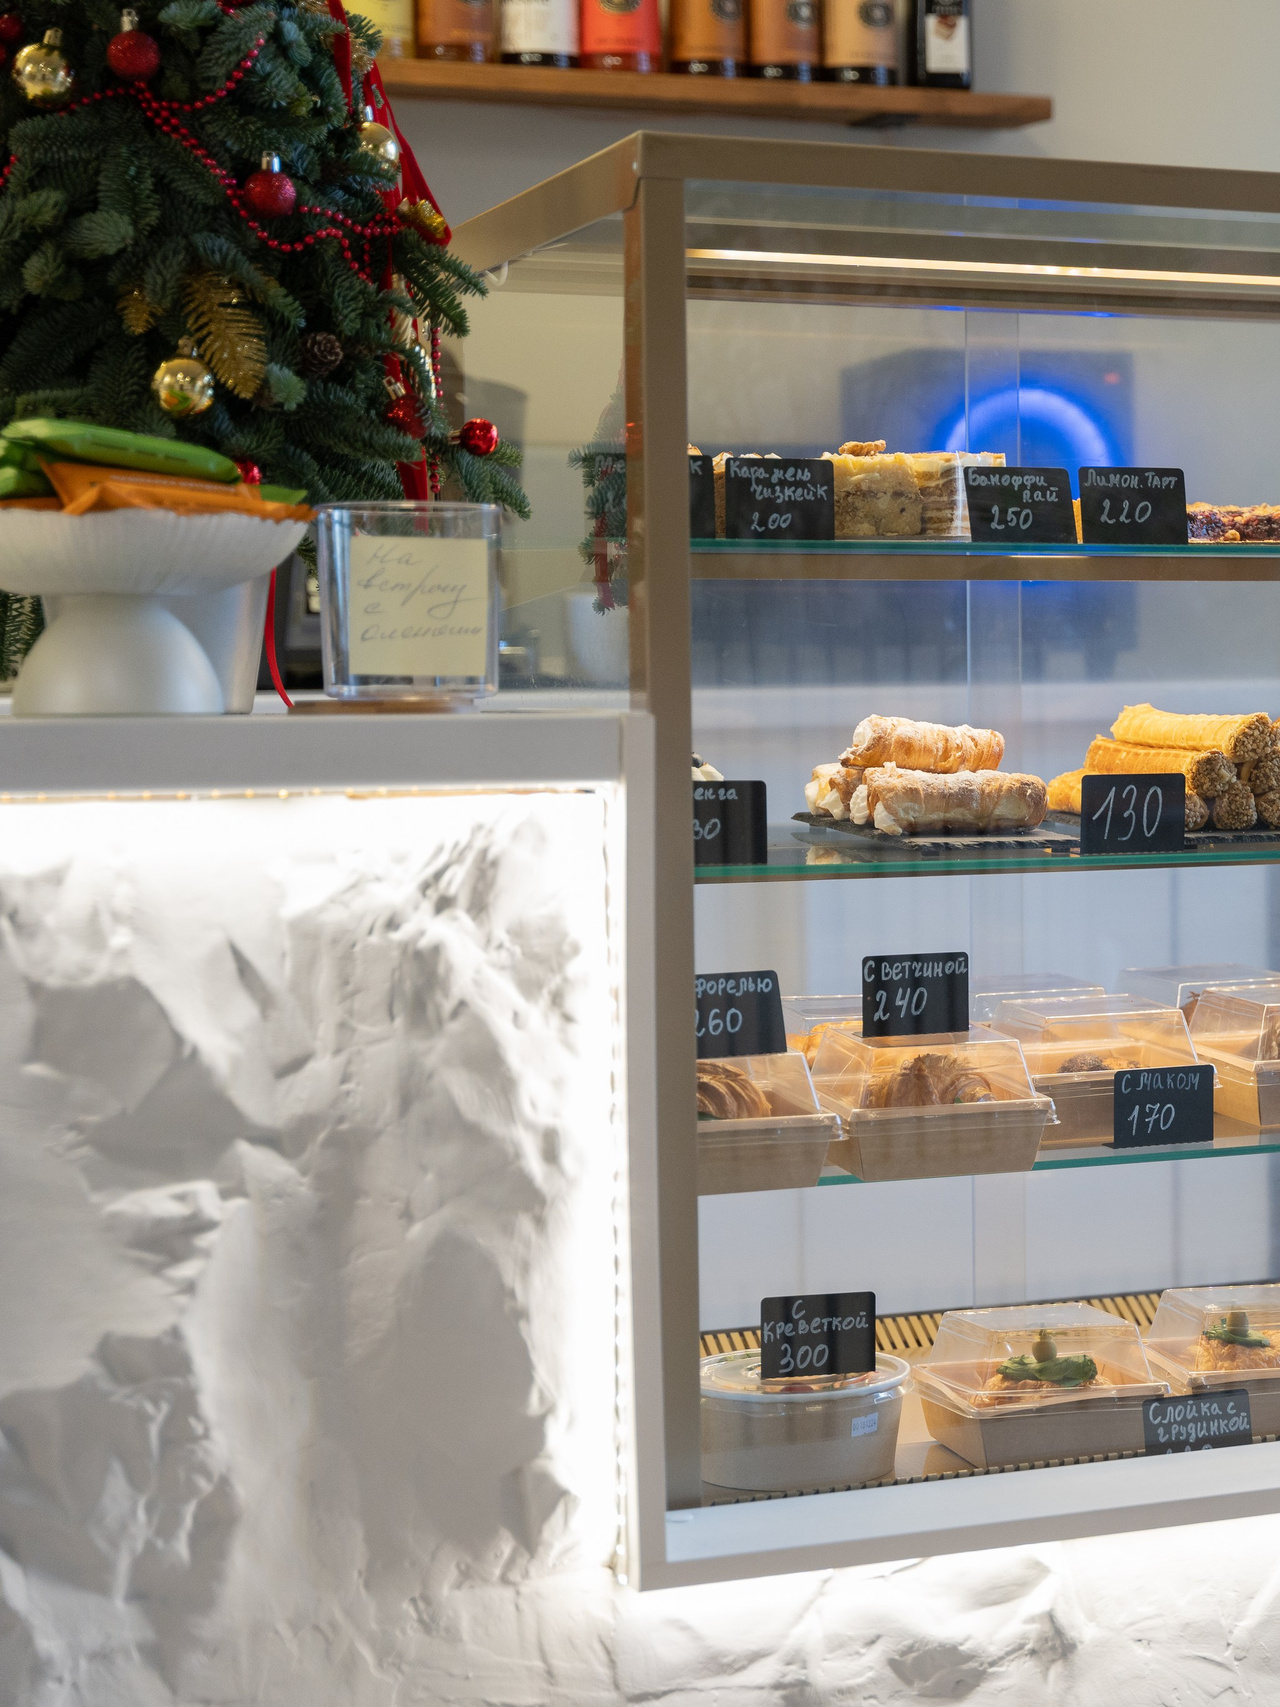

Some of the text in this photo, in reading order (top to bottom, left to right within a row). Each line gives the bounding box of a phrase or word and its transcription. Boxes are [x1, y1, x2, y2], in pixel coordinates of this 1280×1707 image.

[967, 467, 1048, 491] Баноффи
[1022, 486, 1059, 503] пай
[750, 511, 792, 532] 200
[990, 504, 1033, 530] 250
[1100, 498, 1152, 525] 220
[1092, 784, 1163, 841] 130
[873, 986, 928, 1022] 240
[1127, 1102, 1176, 1136] 170
[778, 1343, 829, 1374] 300
[1148, 1400, 1223, 1425] Слойка
[1157, 1412, 1250, 1443] грудинкой
